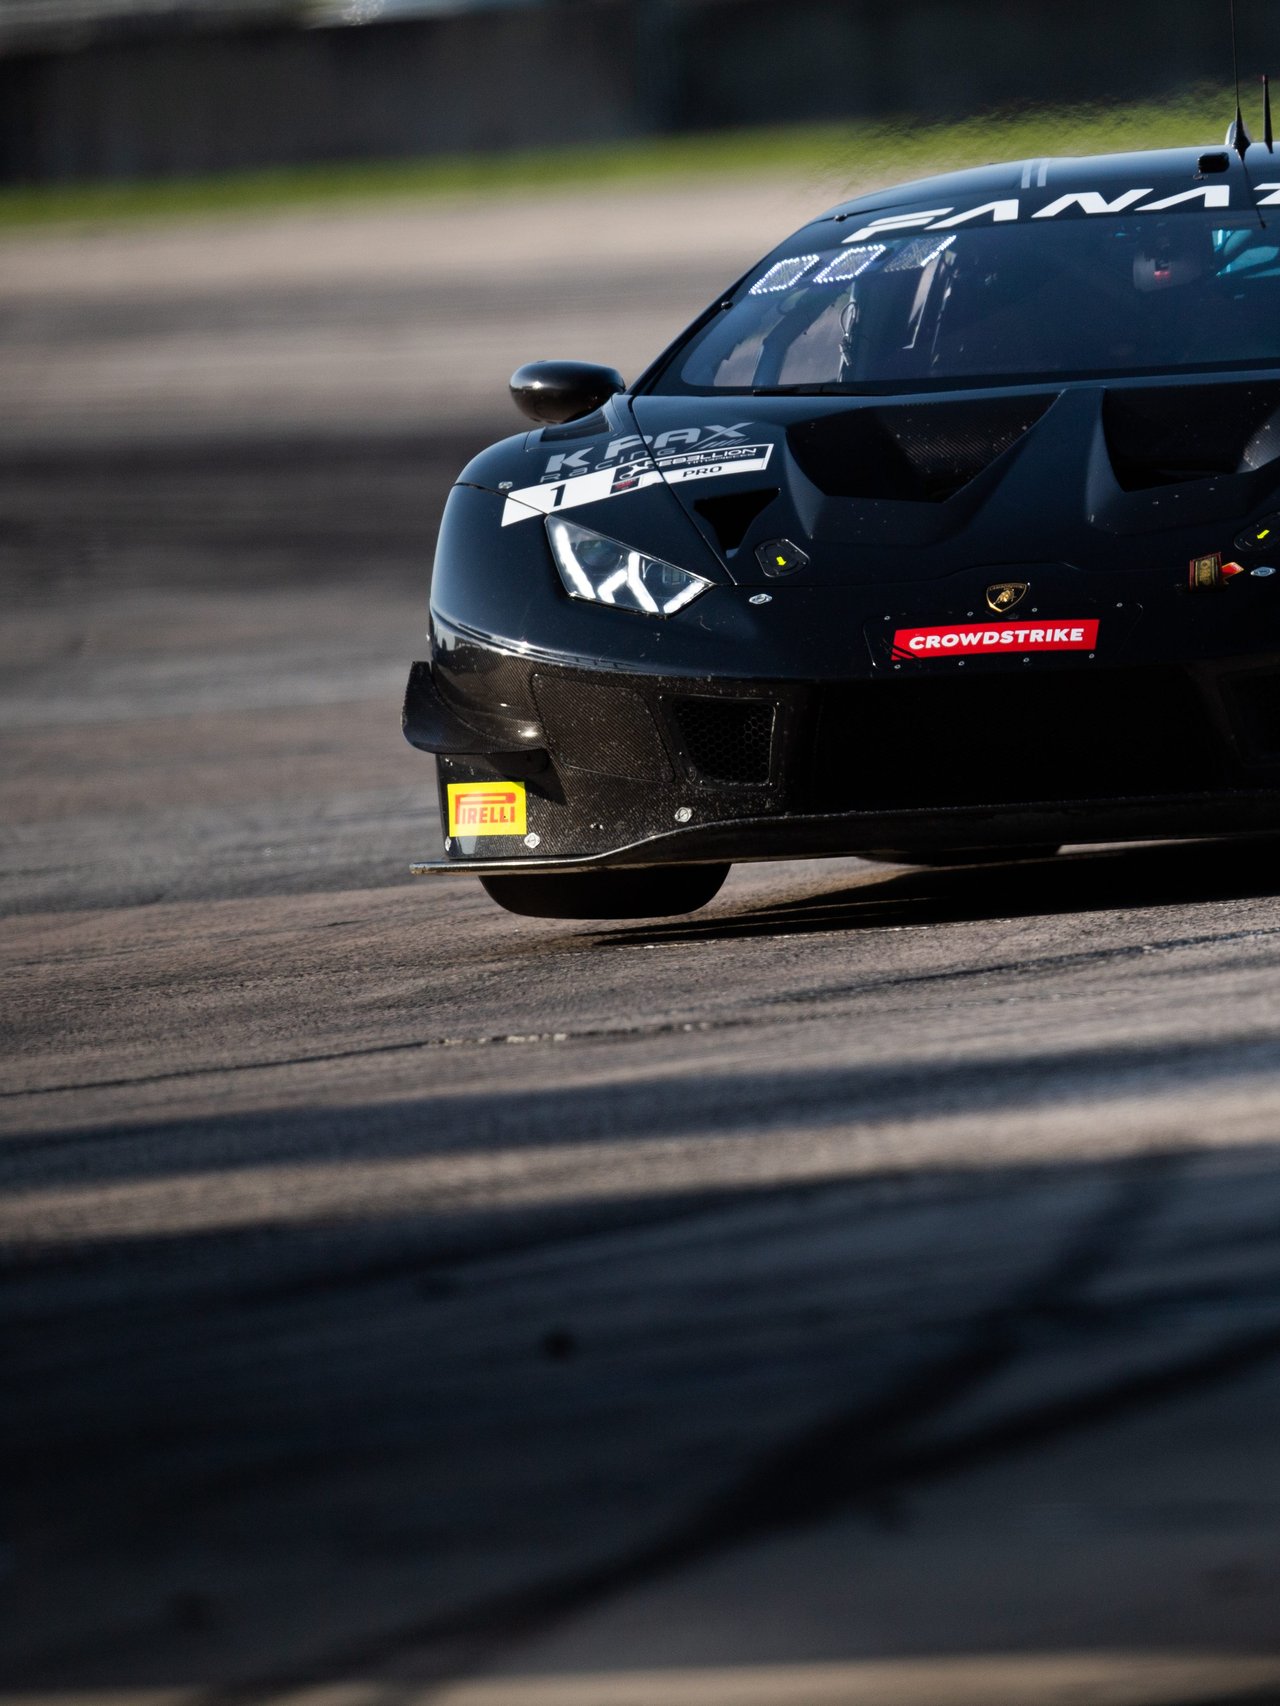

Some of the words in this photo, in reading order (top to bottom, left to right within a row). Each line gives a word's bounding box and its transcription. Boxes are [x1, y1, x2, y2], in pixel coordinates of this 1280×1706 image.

[544, 446, 595, 474] K
[604, 421, 756, 459] PAX
[683, 466, 722, 478] PRO
[550, 484, 567, 506] 1
[908, 627, 1085, 650] CROWDSTRIKE
[455, 792, 517, 825] PIRELLI
